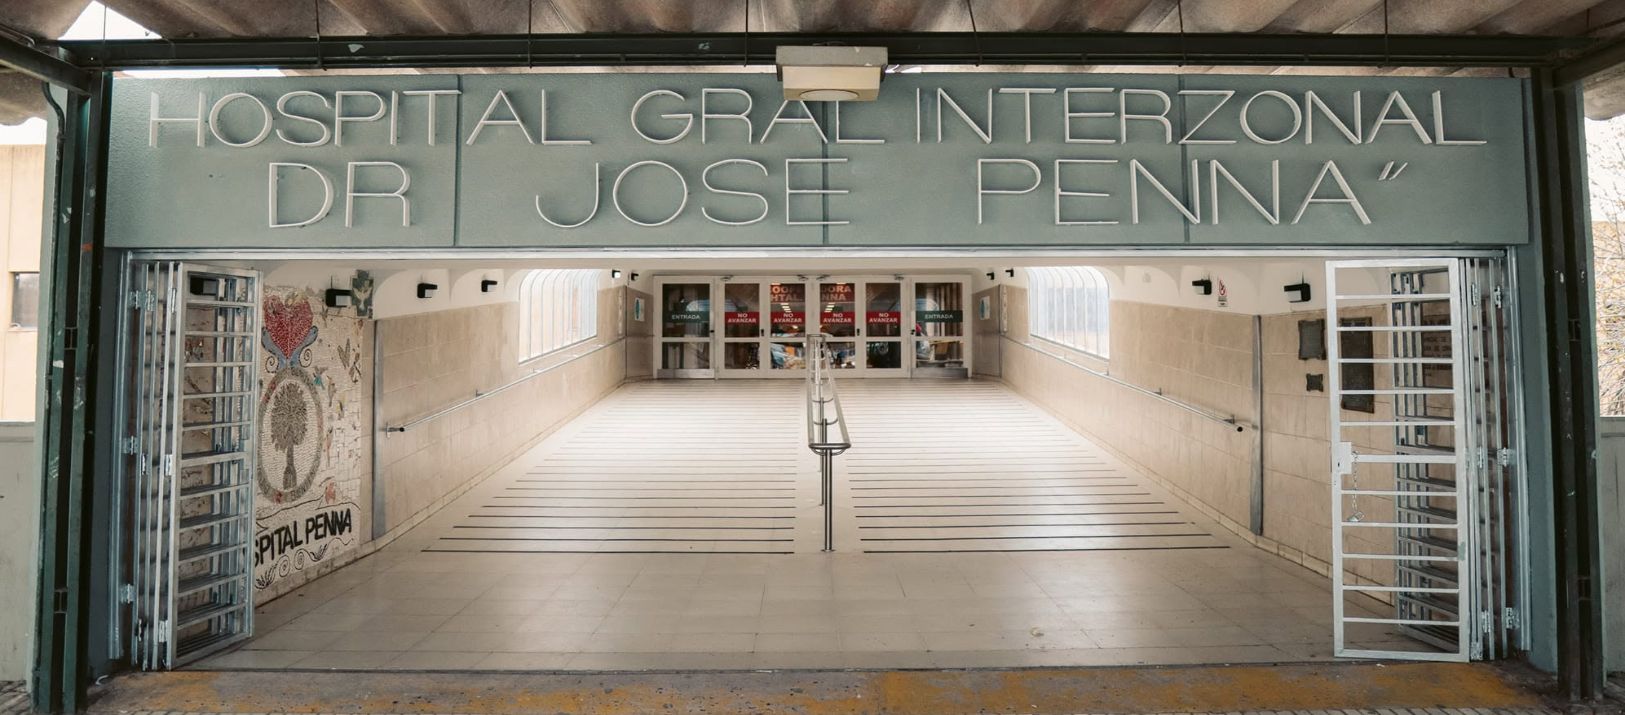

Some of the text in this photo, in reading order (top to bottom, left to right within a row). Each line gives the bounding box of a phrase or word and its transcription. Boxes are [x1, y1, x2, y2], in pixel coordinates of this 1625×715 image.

[149, 87, 1487, 147] HOSPITAL GRAL INTERZONAL
[269, 161, 411, 228] DR
[536, 158, 850, 228] JOSE
[305, 508, 352, 545] PENNA
